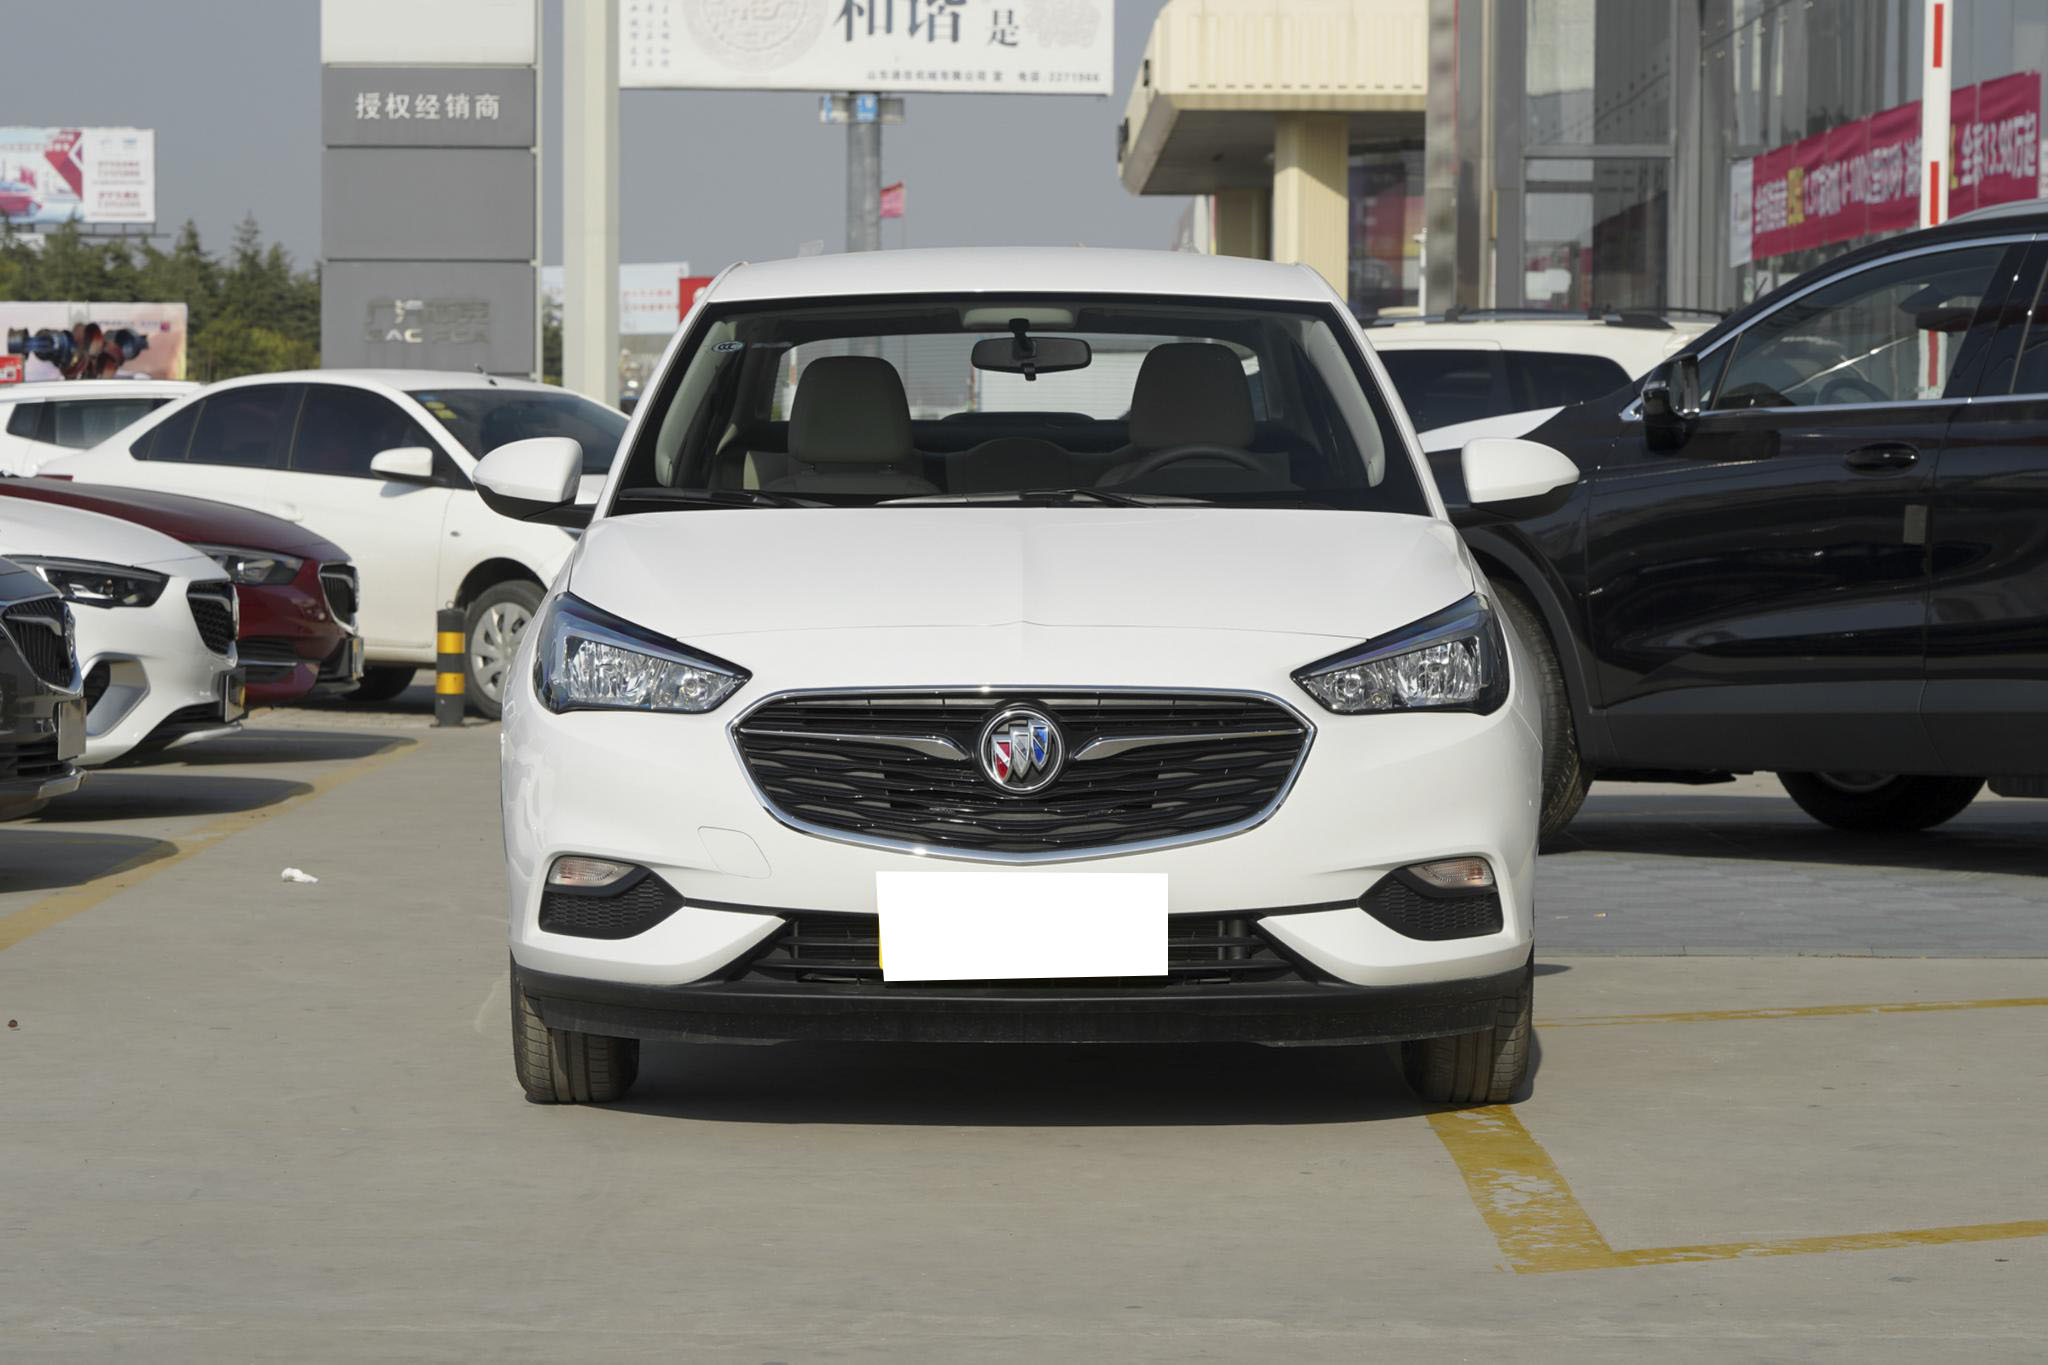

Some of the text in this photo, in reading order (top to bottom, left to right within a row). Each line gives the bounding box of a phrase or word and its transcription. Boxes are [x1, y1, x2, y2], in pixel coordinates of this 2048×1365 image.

[355, 92, 500, 120] 授权经销商
